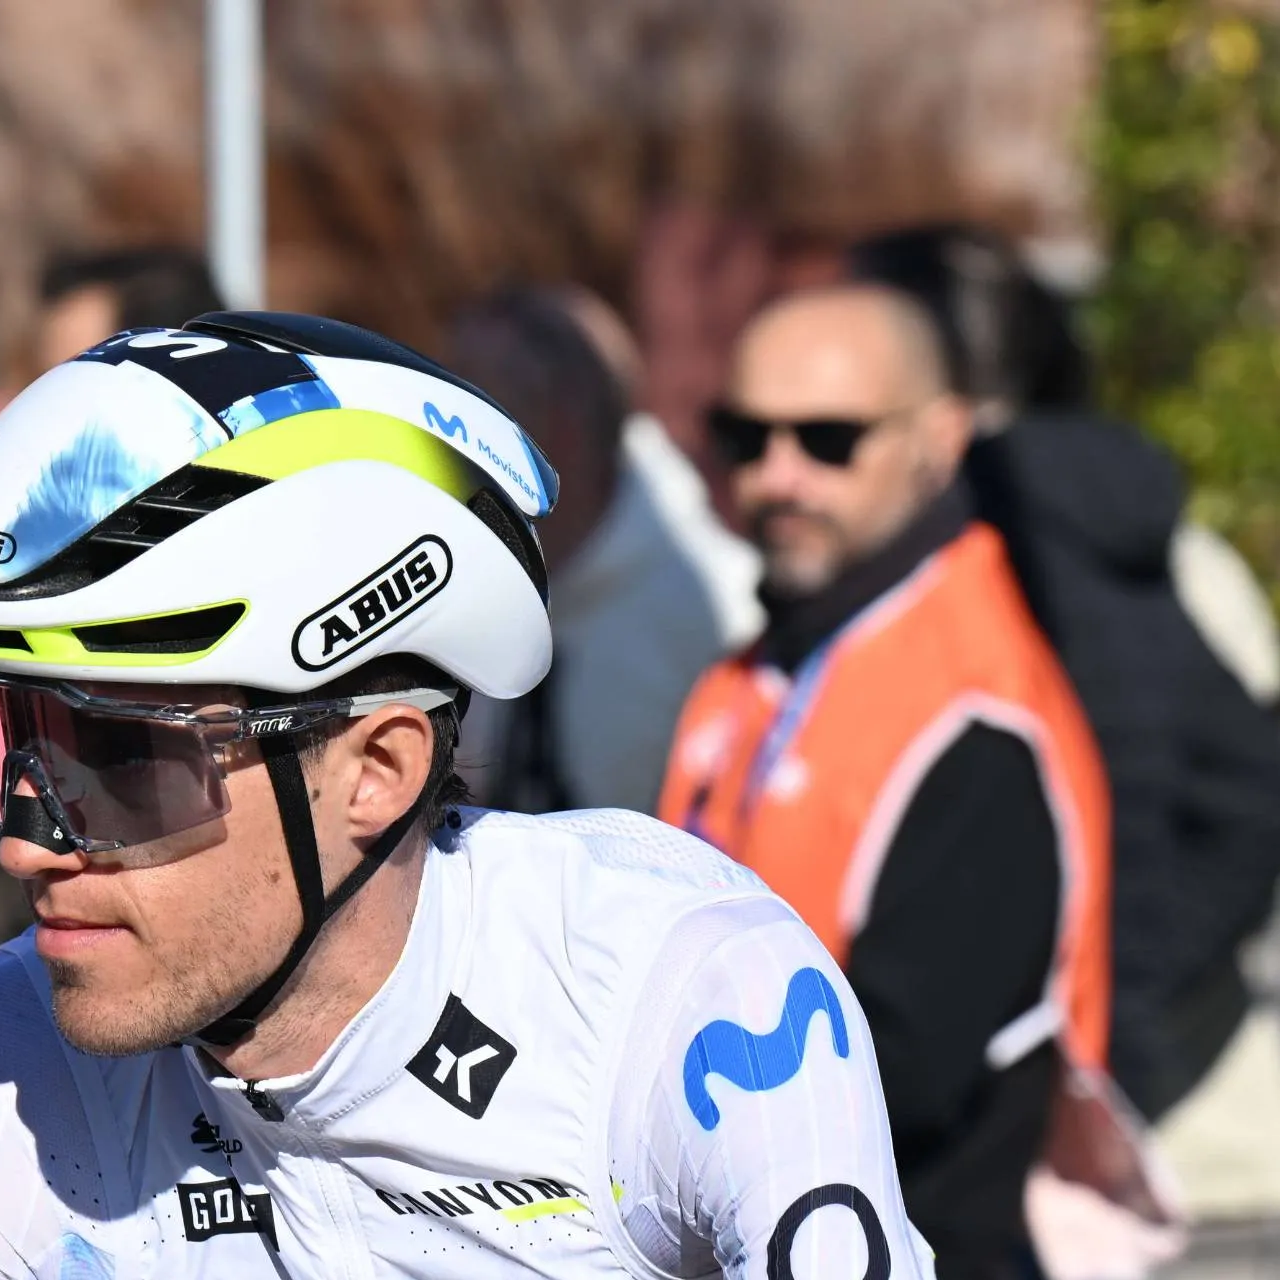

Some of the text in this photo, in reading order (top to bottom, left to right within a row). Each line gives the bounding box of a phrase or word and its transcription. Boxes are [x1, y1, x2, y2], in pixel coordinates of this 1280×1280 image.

[320, 551, 437, 656] ABUS
[250, 715, 293, 735] 100%
[376, 1178, 571, 1217] CANYON
